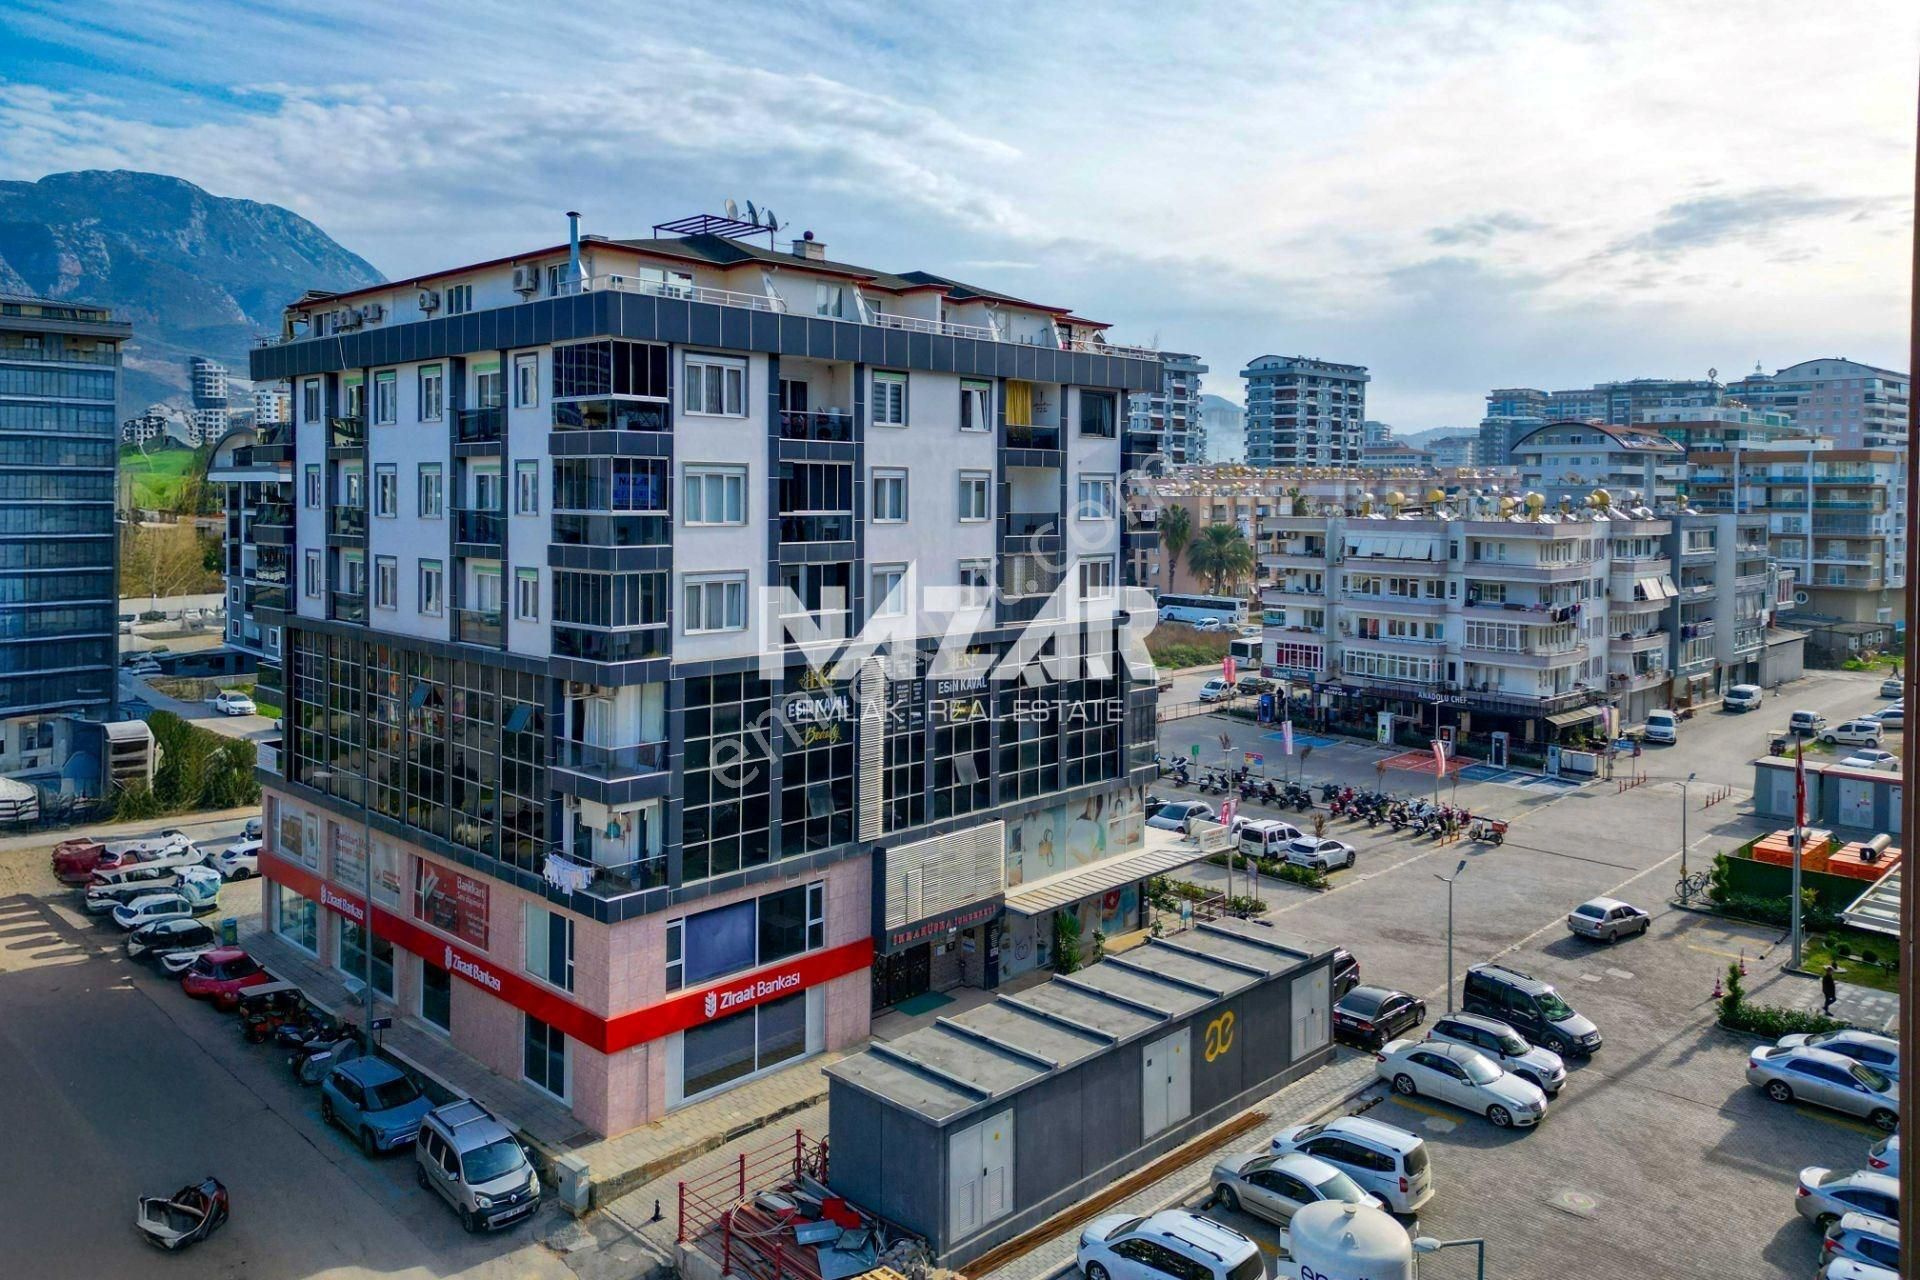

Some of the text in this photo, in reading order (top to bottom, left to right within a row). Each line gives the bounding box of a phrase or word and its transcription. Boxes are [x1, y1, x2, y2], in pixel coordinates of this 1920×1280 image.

[960, 676, 988, 691] KAVAL
[1417, 691, 1468, 704] ANADOLU CHEF
[326, 891, 364, 921] Ziraat Bankası
[453, 954, 501, 992] Ziraat Bankası
[720, 972, 800, 1009] Ziraat Bankası
